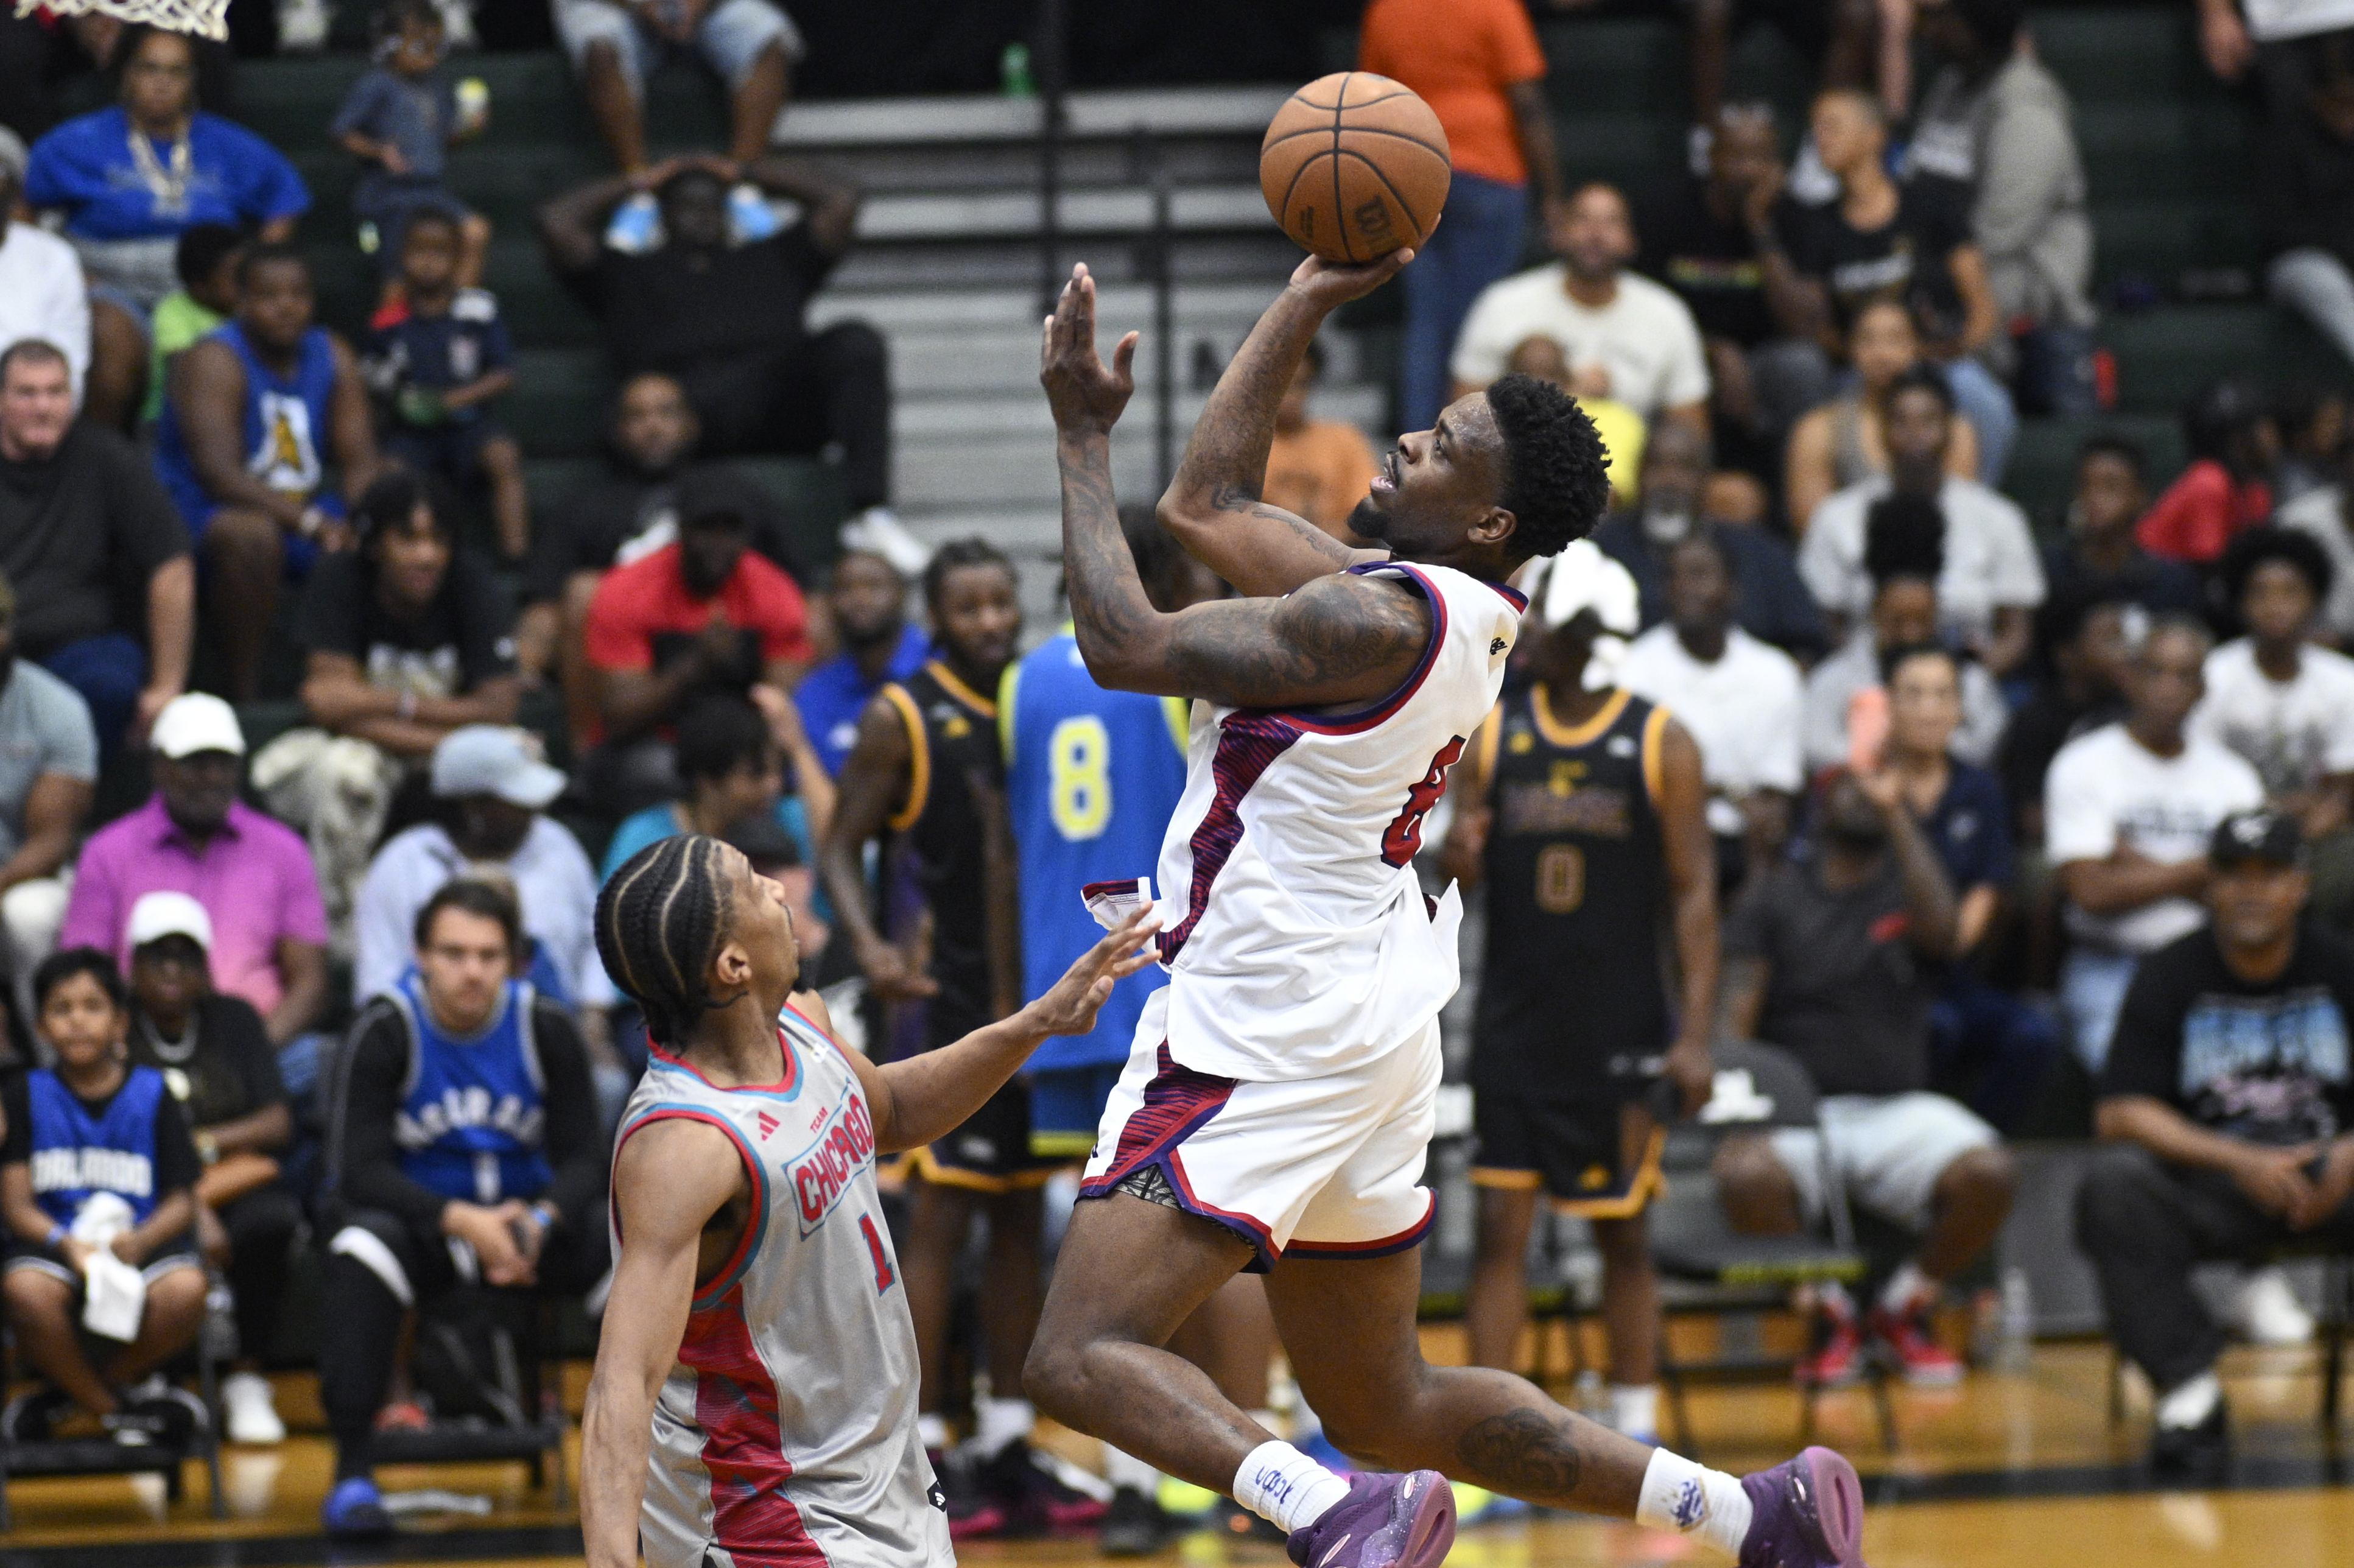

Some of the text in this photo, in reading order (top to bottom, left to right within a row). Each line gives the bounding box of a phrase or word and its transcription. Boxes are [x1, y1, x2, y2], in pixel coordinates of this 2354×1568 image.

[1049, 714, 1113, 842] 8
[1535, 844, 1585, 913] 0
[796, 1093, 874, 1223] CHICAGO
[810, 1106, 829, 1134] TEAM
[858, 1211, 895, 1297] 1
